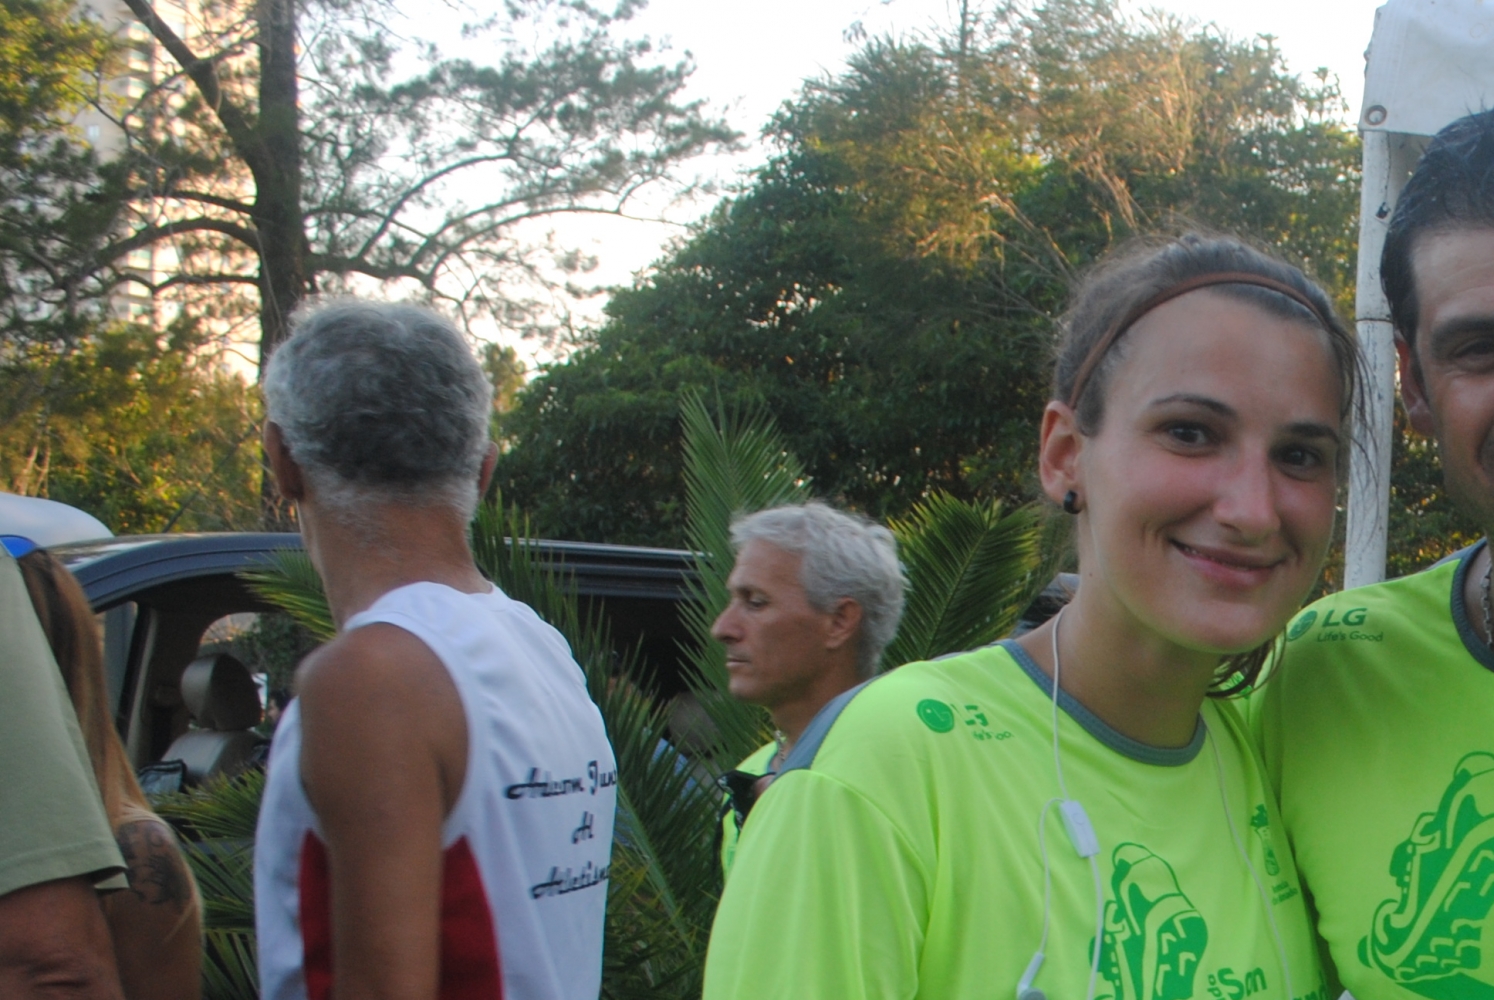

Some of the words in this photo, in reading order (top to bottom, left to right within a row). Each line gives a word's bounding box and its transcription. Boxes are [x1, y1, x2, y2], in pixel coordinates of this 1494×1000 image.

[1321, 607, 1368, 627] LG
[1317, 631, 1346, 642] Life's
[1349, 630, 1384, 642] Good
